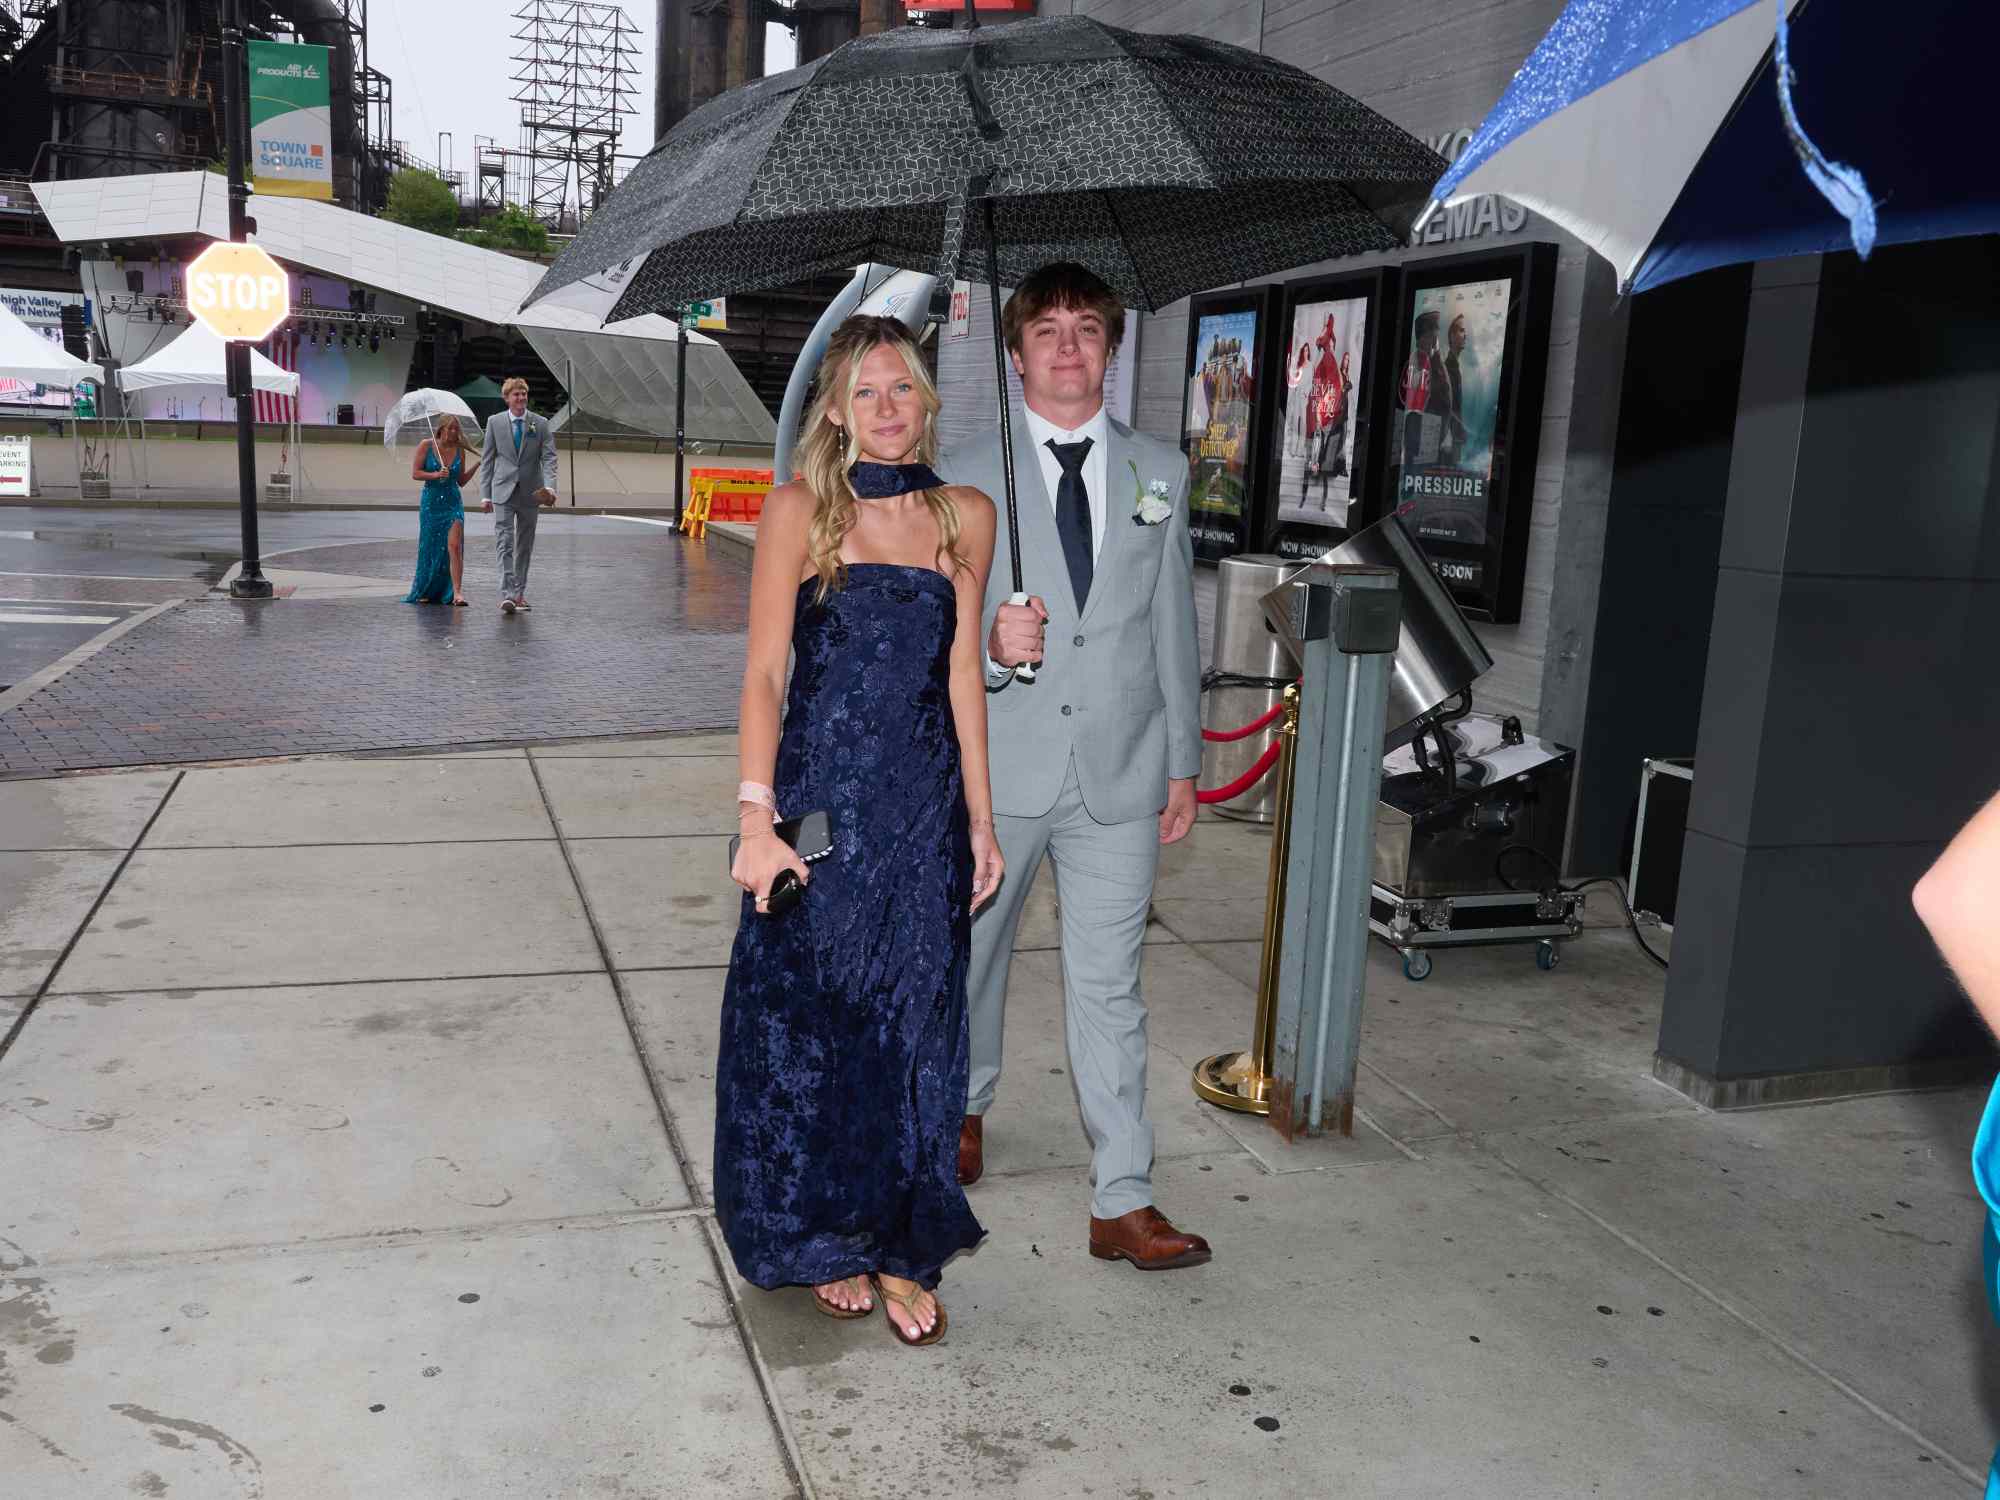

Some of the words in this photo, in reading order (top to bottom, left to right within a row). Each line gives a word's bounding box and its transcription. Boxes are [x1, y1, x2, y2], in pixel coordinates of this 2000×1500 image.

[260, 140, 307, 155] TOWN
[260, 153, 323, 169] SQUARE
[1411, 194, 1527, 244] EMAS
[195, 272, 279, 311] STOP
[0, 294, 26, 305] high
[27, 296, 62, 309] Valley
[11, 304, 26, 316] lth
[28, 307, 64, 318] Netwo
[0, 450, 22, 458] VENT
[1404, 475, 1483, 497] PRESSURE
[1188, 527, 1203, 538] NOW
[1204, 528, 1235, 544] SHOWING
[1281, 541, 1298, 553] NOW
[1300, 543, 1333, 557] SHOWI
[1441, 563, 1473, 580] SOON
